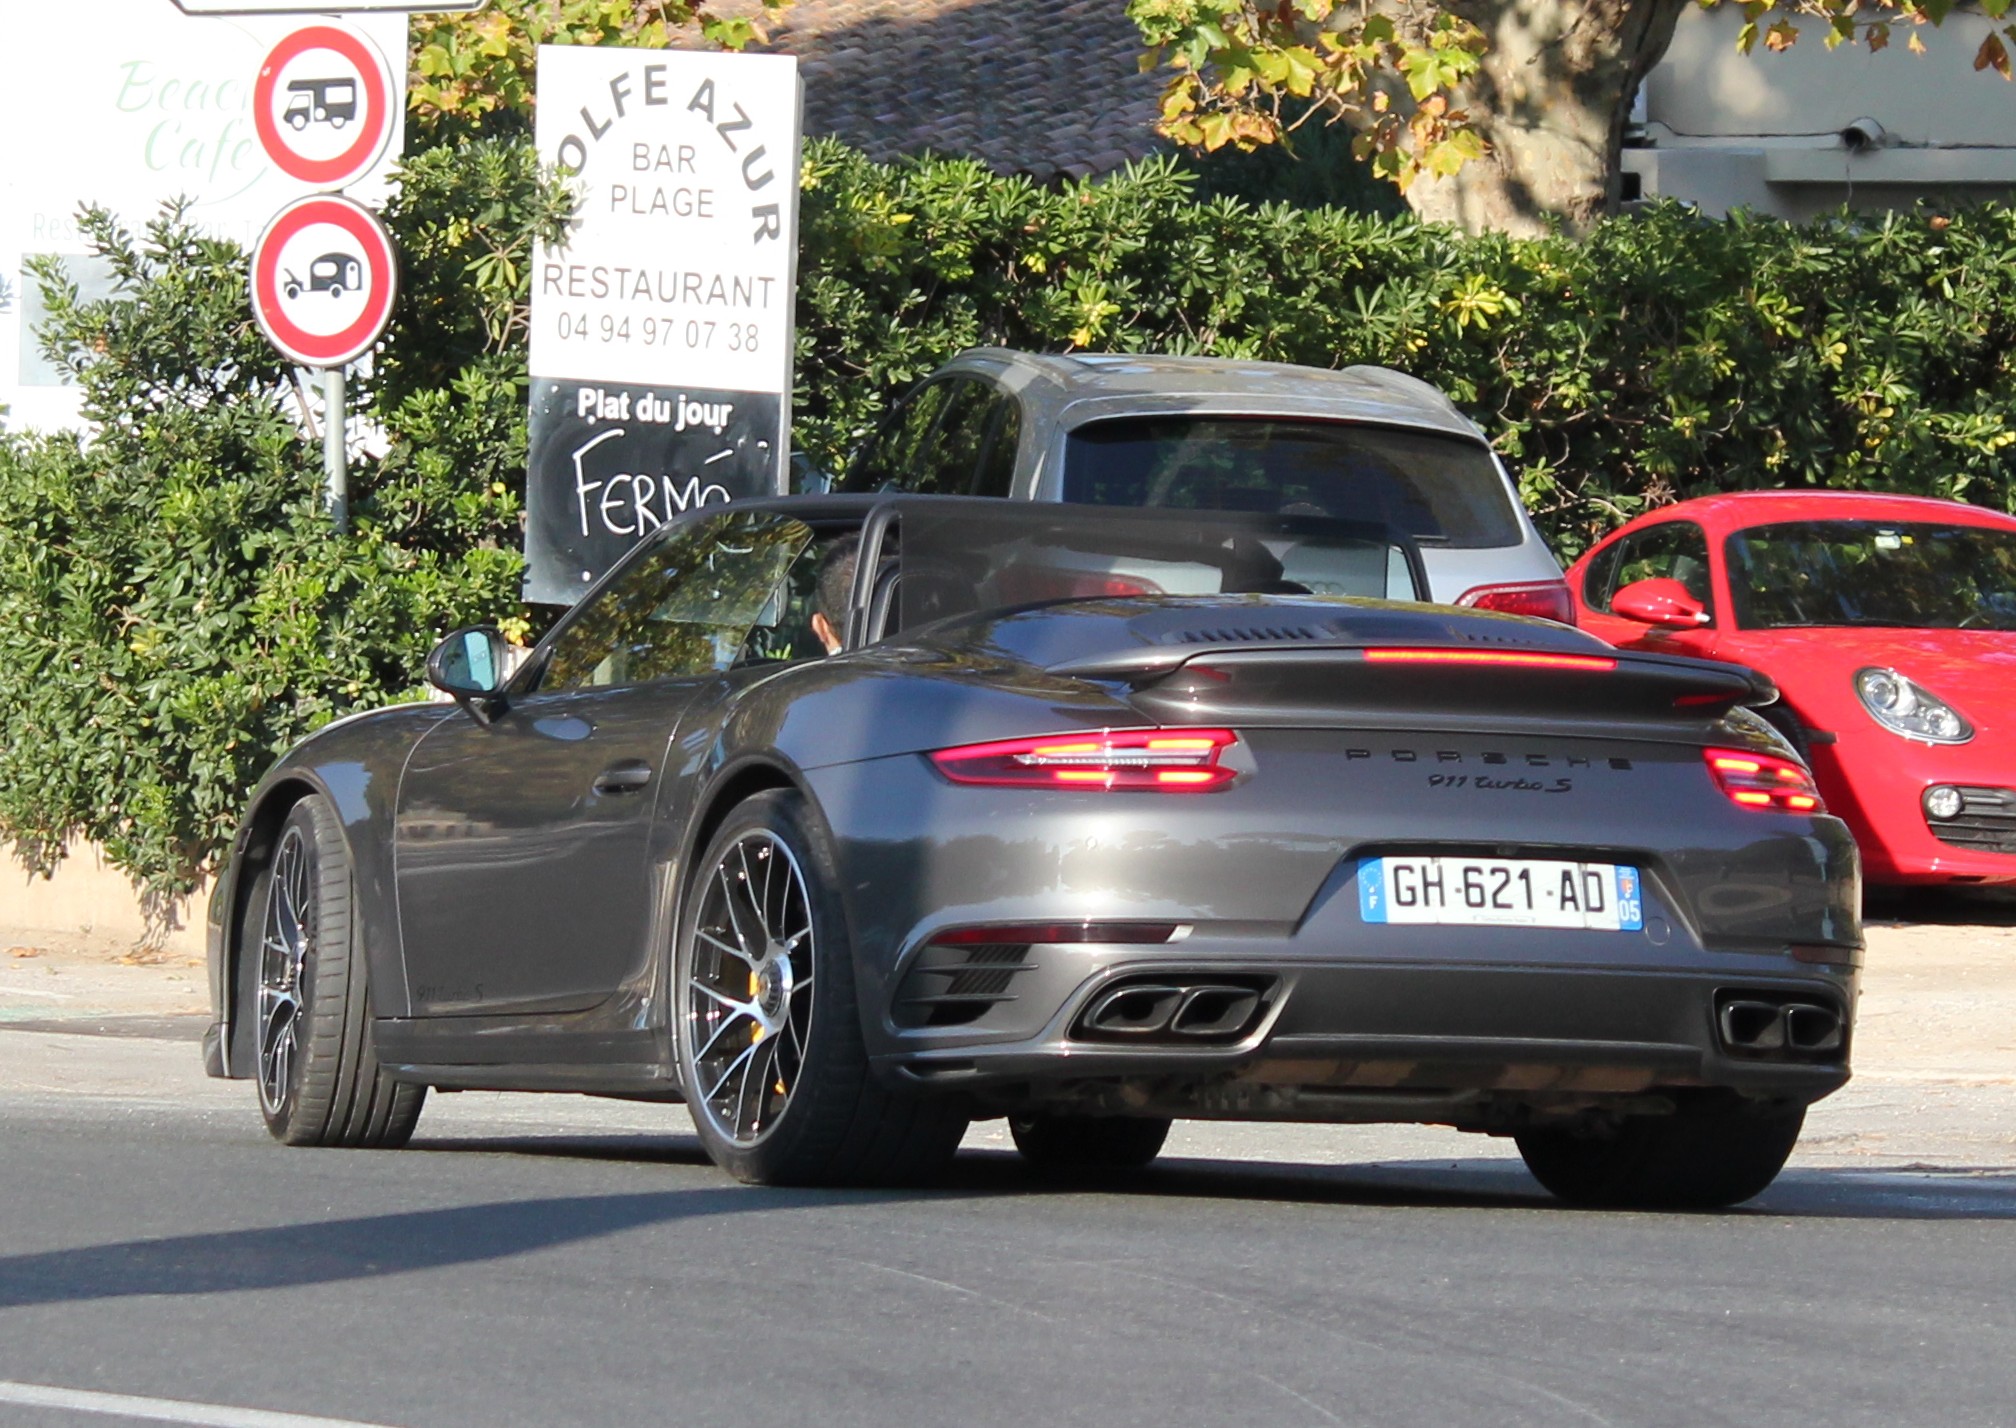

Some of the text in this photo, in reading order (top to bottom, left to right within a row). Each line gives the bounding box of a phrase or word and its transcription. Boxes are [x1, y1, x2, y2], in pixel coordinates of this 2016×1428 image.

[143, 117, 254, 184] Cafe
[557, 64, 782, 246] OLFE AZUR
[632, 142, 696, 174] BAR
[610, 184, 714, 218] PLAGE
[543, 263, 776, 309] RESTAURANT
[557, 311, 759, 352] 04 94 97 07 38
[577, 387, 733, 432] Plat du jour
[1345, 749, 1634, 771] PORSCHE
[1428, 774, 1573, 793] 911 turbo S
[1368, 895, 1379, 910] F
[1619, 899, 1641, 922] 05
